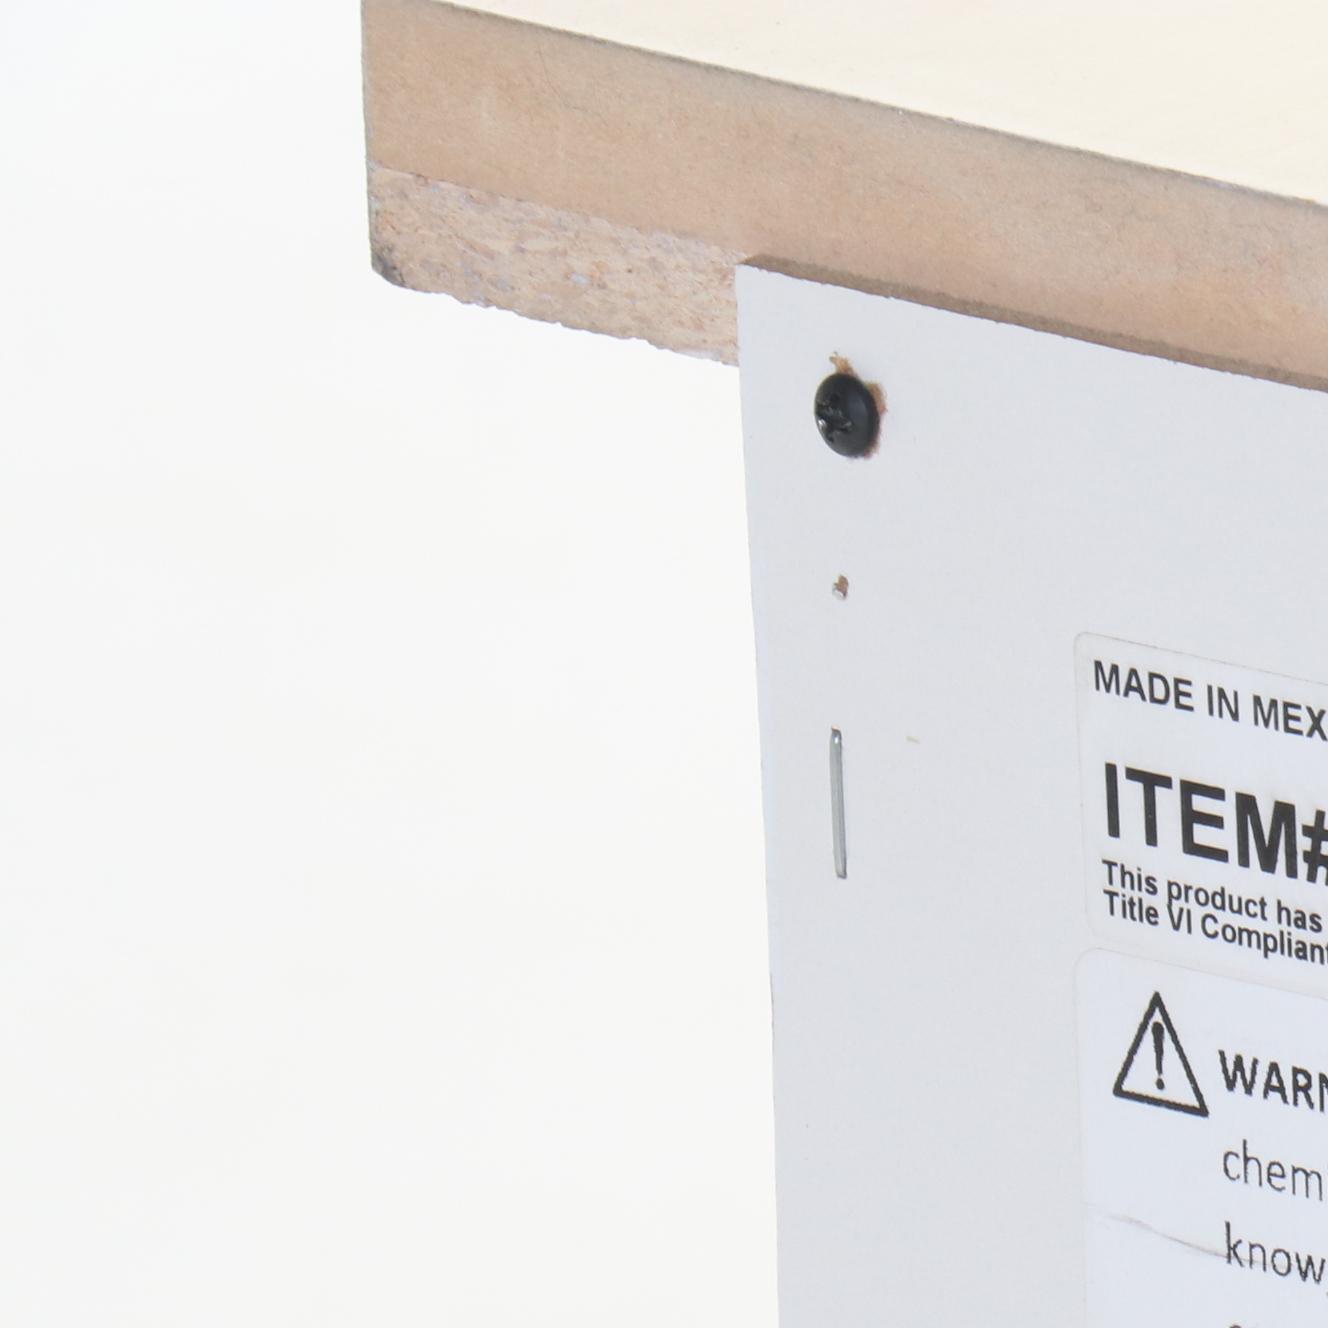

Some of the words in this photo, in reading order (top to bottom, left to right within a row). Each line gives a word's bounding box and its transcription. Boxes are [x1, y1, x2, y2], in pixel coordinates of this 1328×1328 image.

[1094, 660, 1195, 712] MADE
[1207, 684, 1239, 722] IN
[1102, 860, 1157, 895] This
[1167, 878, 1268, 921] product
[1277, 900, 1322, 934] has
[1103, 890, 1159, 926] Title
[1167, 905, 1192, 934] VI
